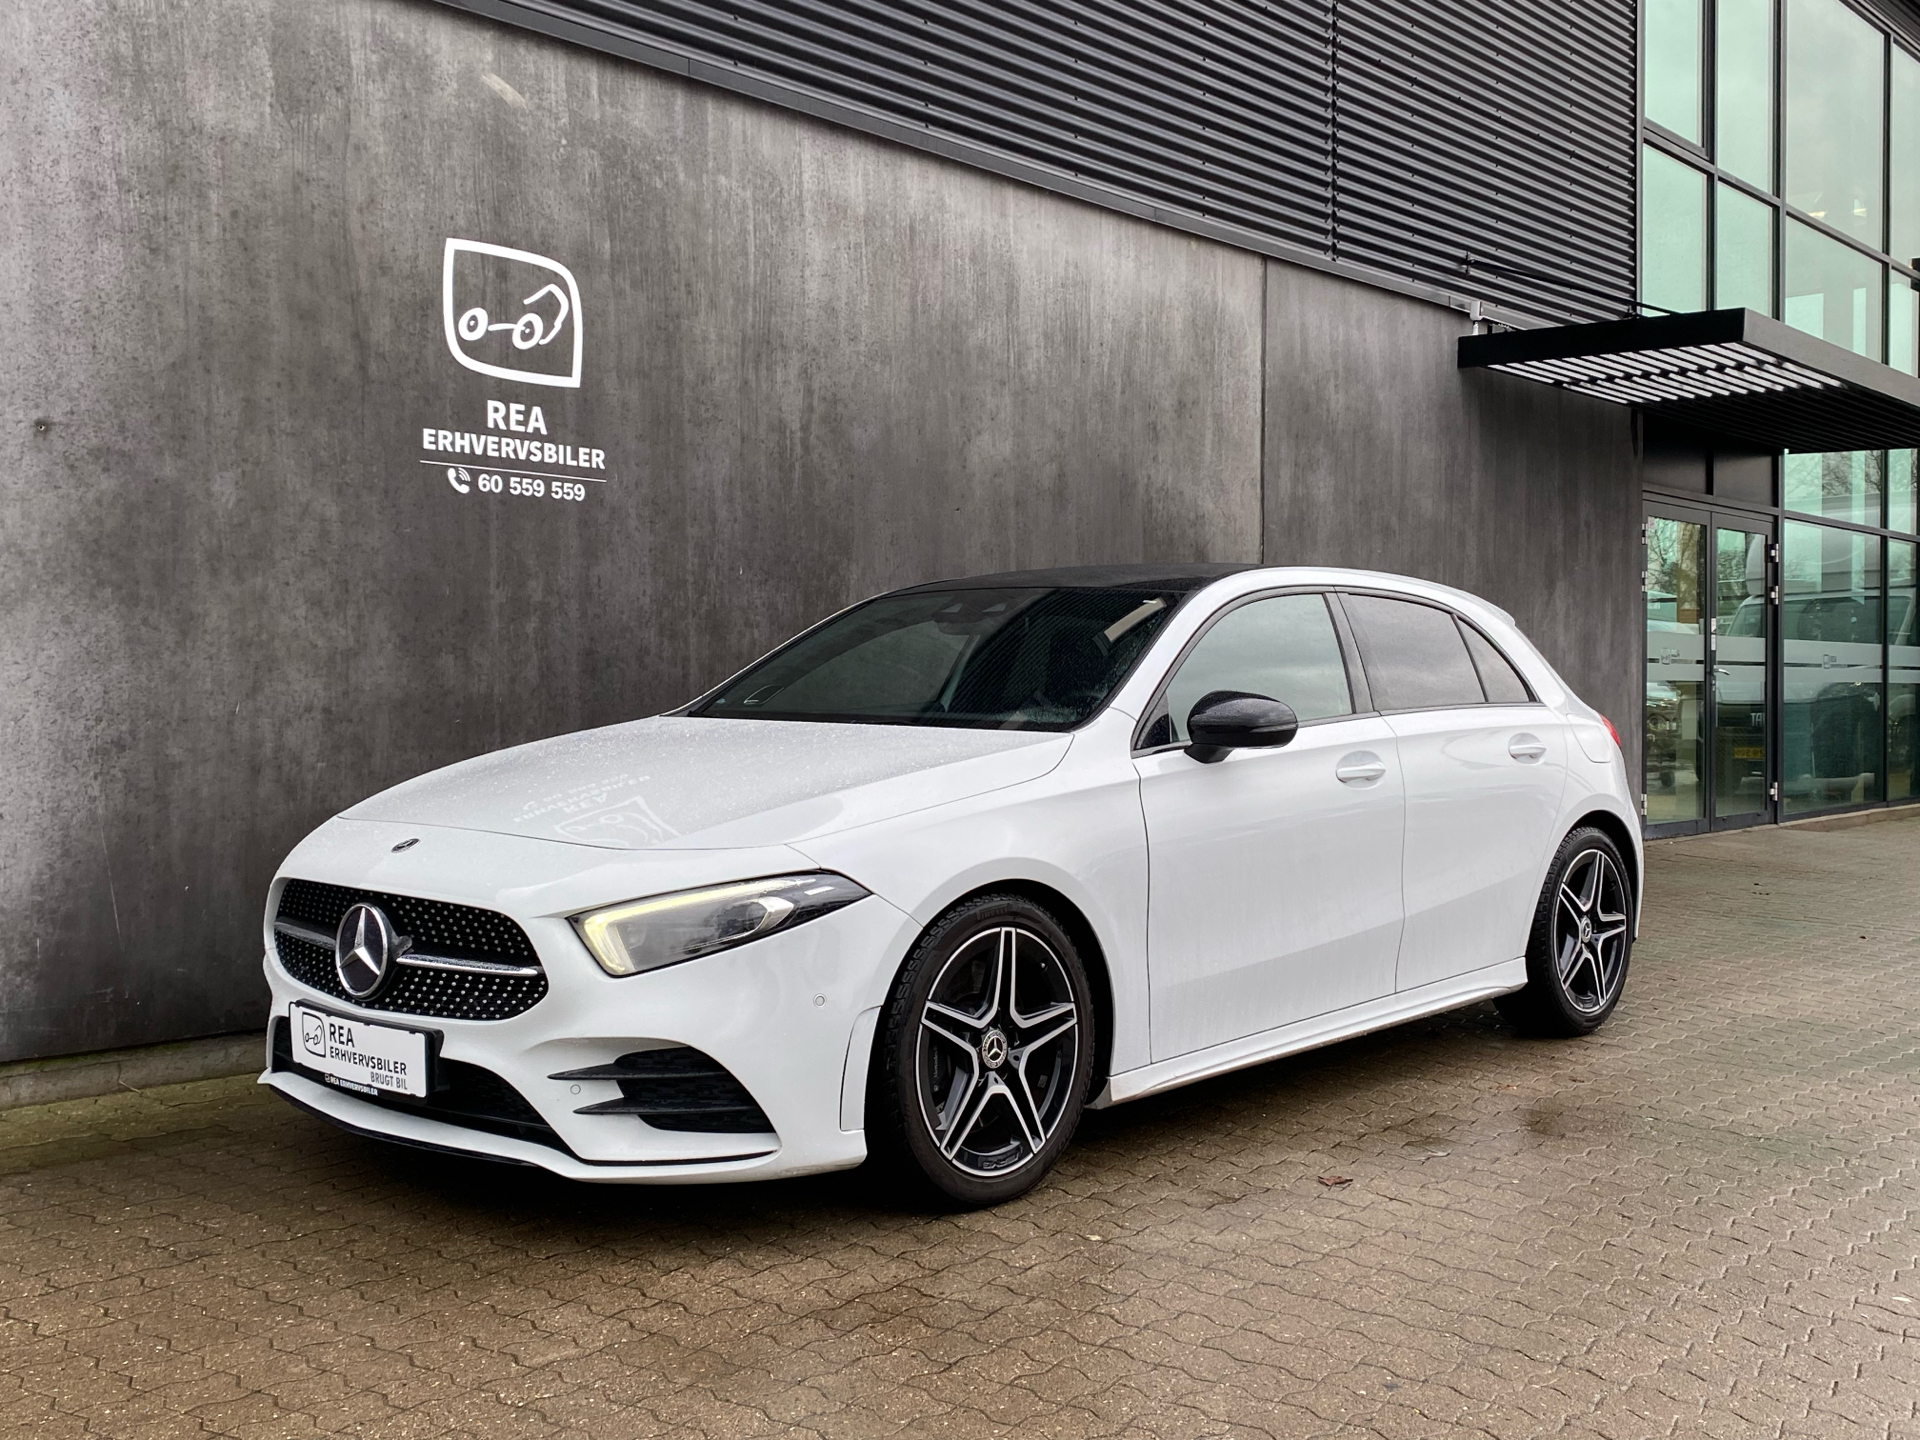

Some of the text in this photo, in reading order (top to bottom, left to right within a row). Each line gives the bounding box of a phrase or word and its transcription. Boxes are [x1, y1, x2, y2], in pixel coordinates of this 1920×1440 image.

[487, 400, 547, 435] REA
[422, 428, 606, 469] ERHVERVSBILER
[477, 474, 586, 501] 60 559 559
[330, 1023, 355, 1047] REA
[330, 1046, 407, 1075] ERHVERVSBILER
[370, 1072, 408, 1090] BRUGT BIL
